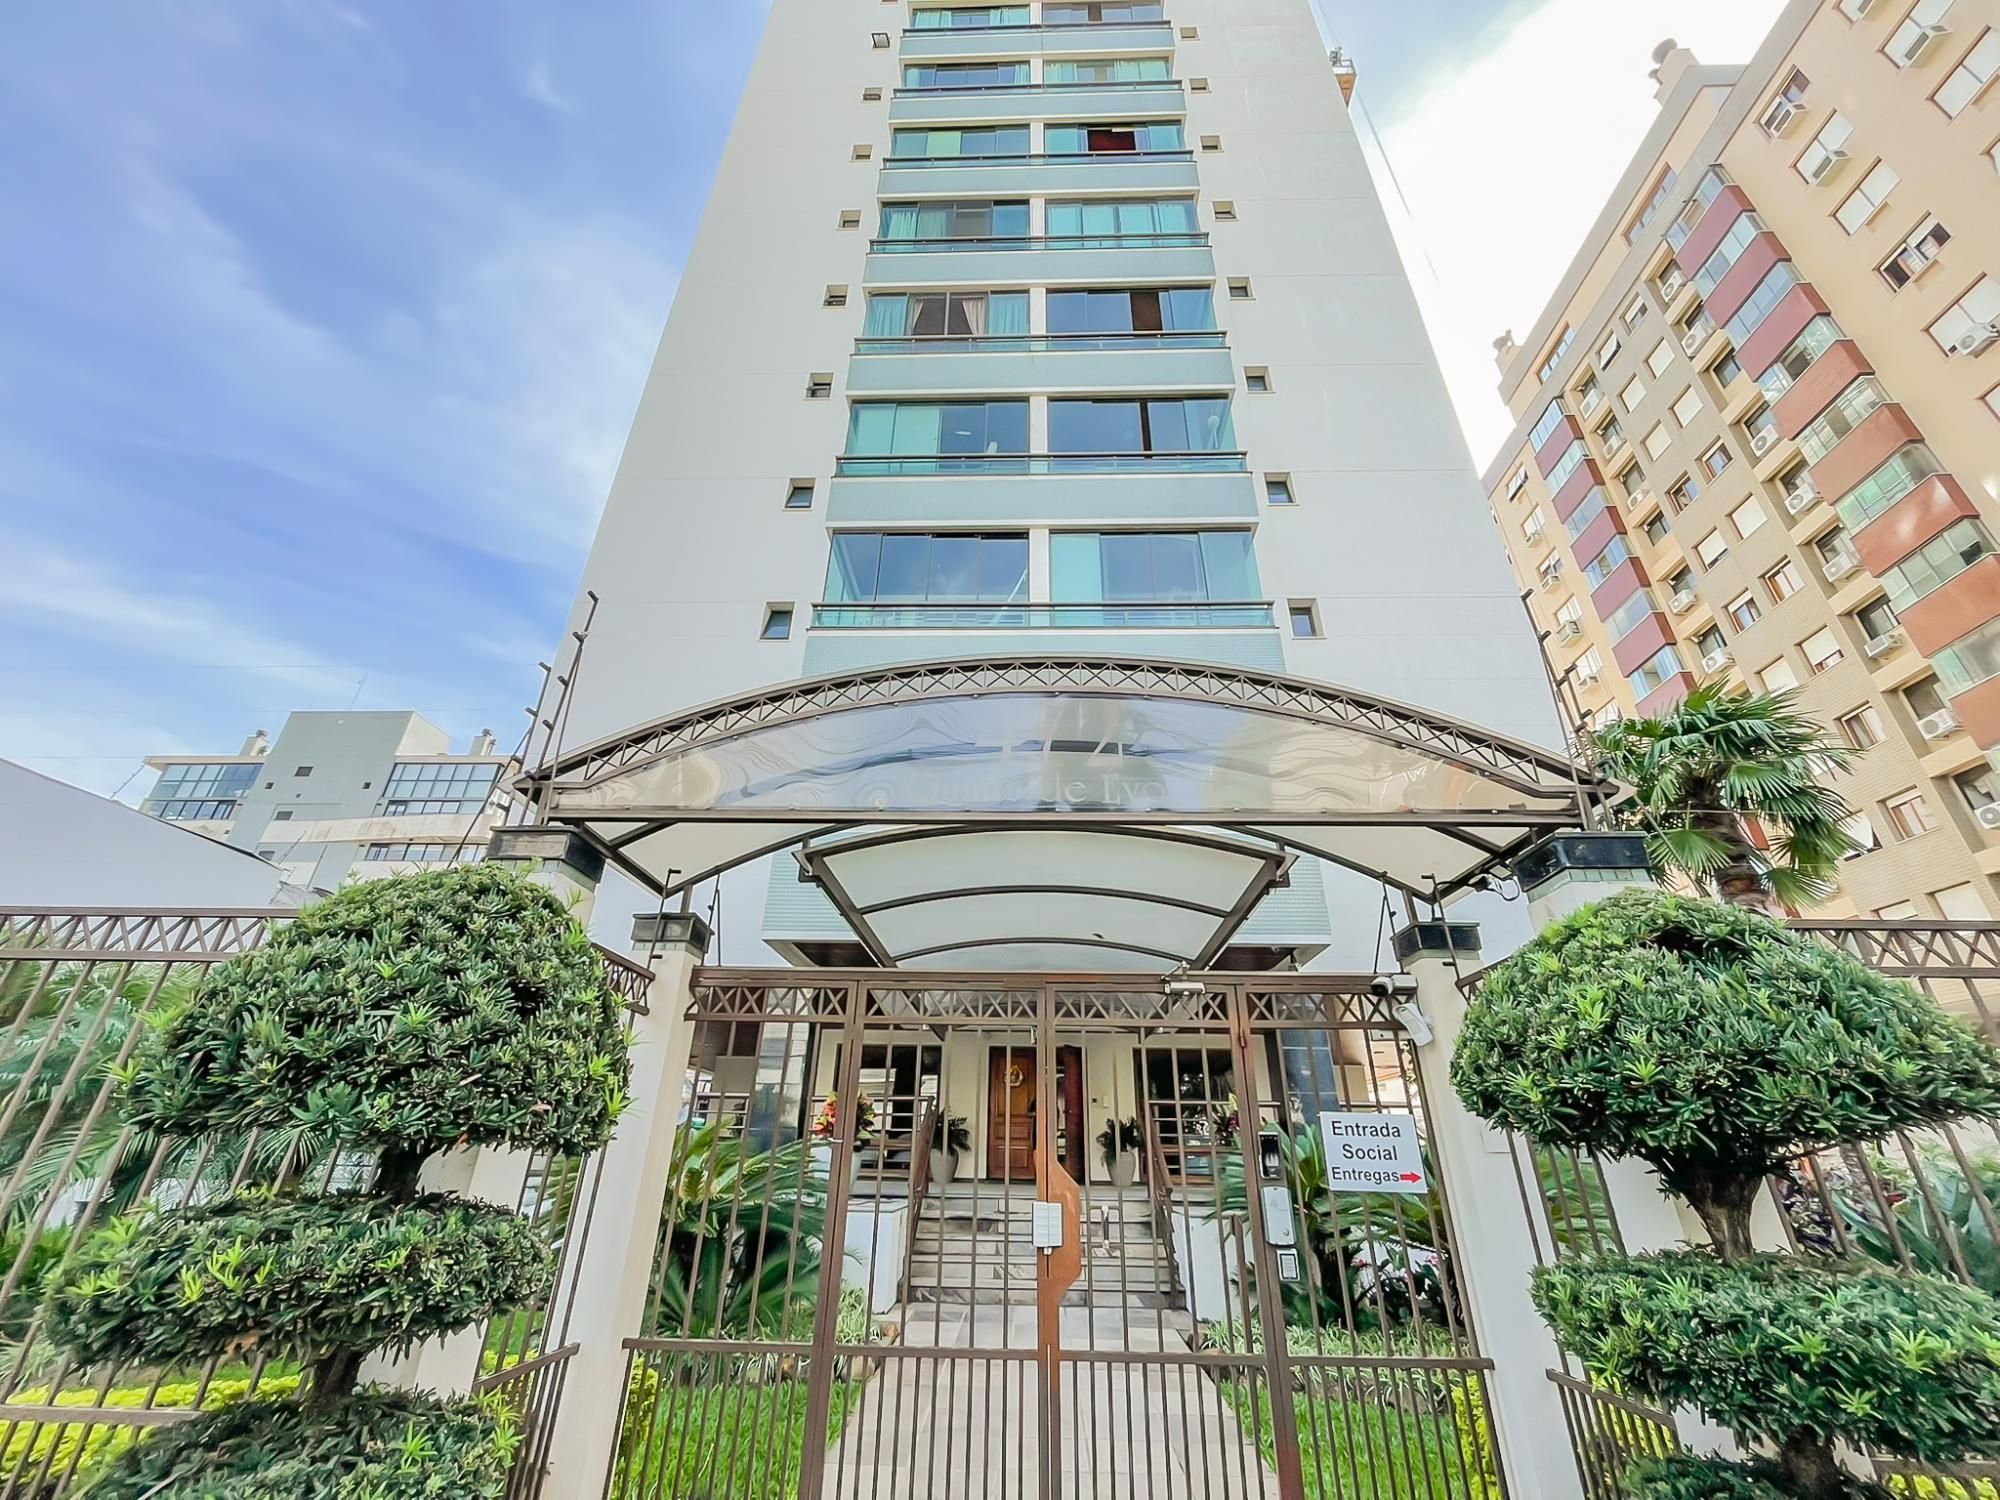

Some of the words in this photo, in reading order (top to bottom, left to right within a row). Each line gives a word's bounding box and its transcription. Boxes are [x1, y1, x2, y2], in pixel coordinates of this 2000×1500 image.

[1331, 1120, 1401, 1138] Entrada
[1342, 1143, 1398, 1161] Social
[1331, 1166, 1400, 1185] Entregas
